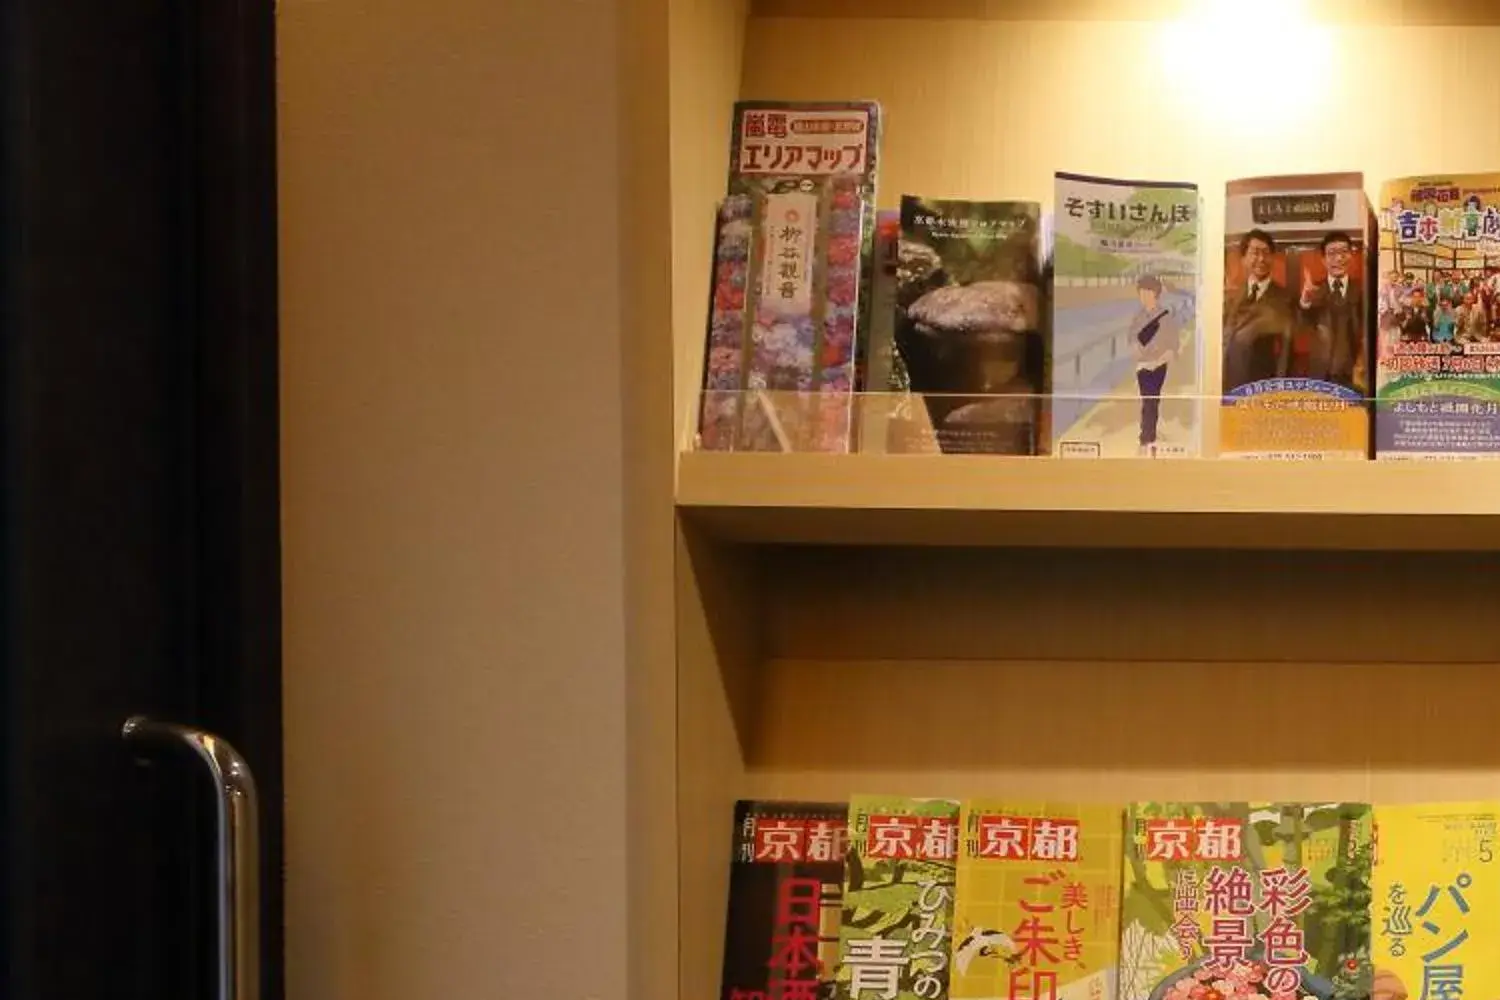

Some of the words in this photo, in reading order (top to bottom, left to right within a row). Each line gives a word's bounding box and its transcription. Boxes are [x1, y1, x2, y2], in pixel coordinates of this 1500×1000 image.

[745, 113, 787, 139] 嵐電
[742, 143, 864, 171] エリアマップ
[1393, 401, 1498, 416] よしもと祇園花月
[756, 820, 850, 861] 京都
[869, 818, 960, 859] 京都
[981, 818, 1079, 860] 京都
[1149, 819, 1242, 861] 京都
[1479, 838, 1493, 863] 5
[910, 880, 951, 998] ひみつの
[1202, 866, 1255, 971] 絶景
[1260, 866, 1313, 993] 彩色の
[1381, 882, 1413, 958] を巡る
